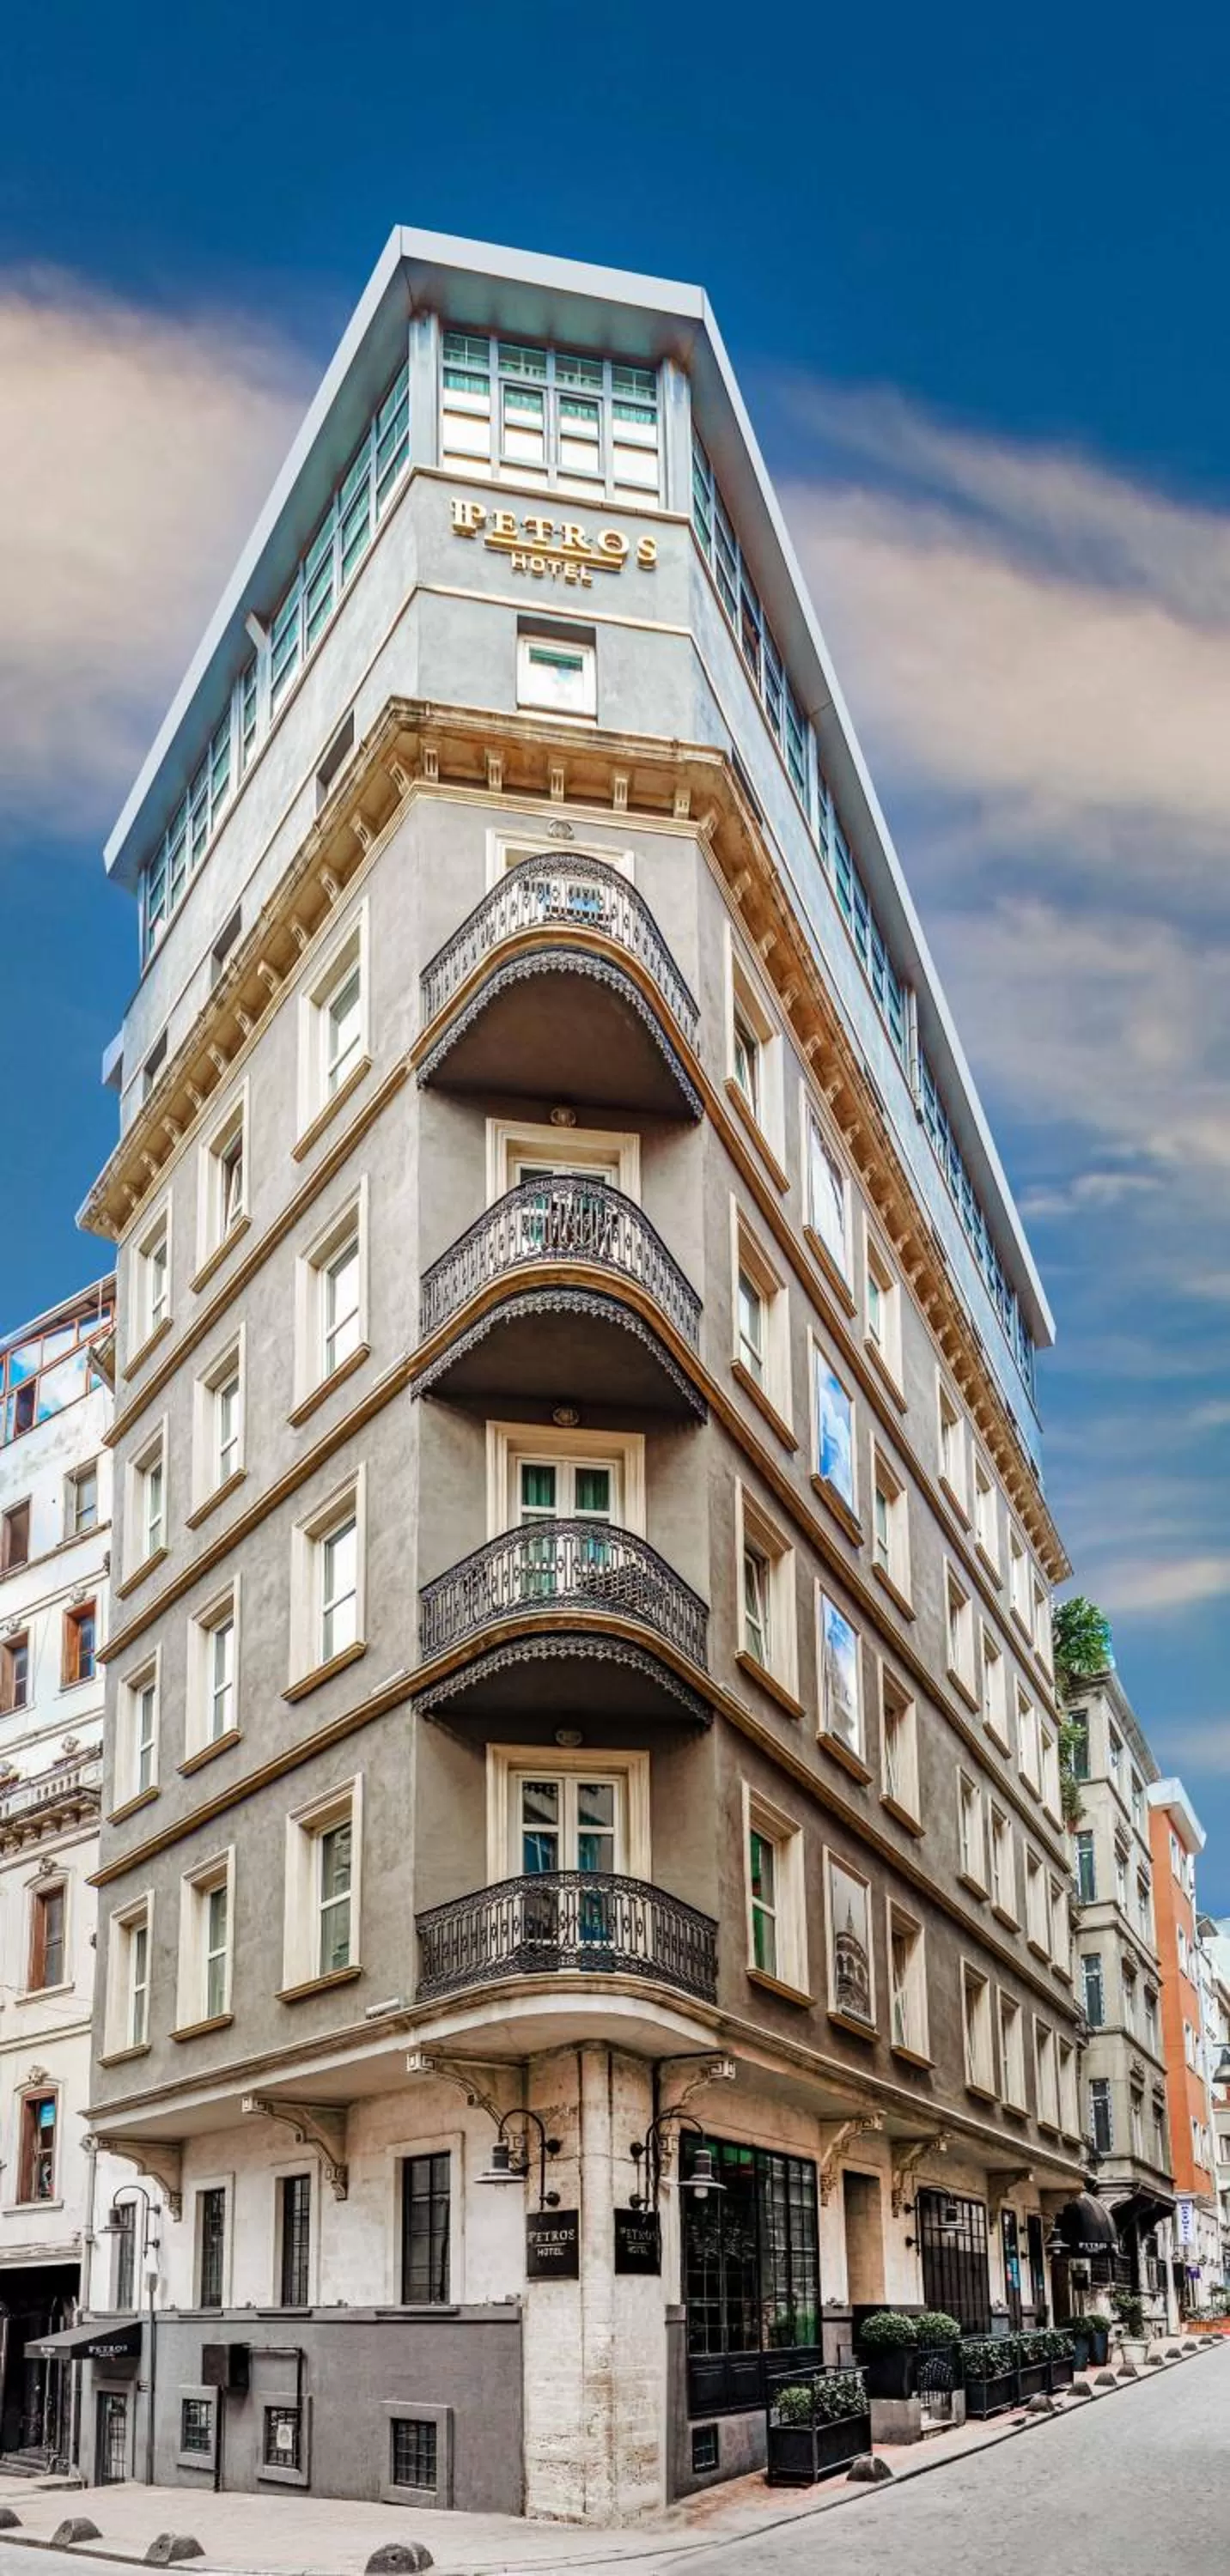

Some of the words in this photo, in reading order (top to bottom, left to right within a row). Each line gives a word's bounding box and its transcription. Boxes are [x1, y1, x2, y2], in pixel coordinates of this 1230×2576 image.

[451, 496, 658, 569] PETROS
[511, 552, 593, 587] HOTEL
[527, 2228, 575, 2243] PETROS
[537, 2247, 564, 2257] HOTEL
